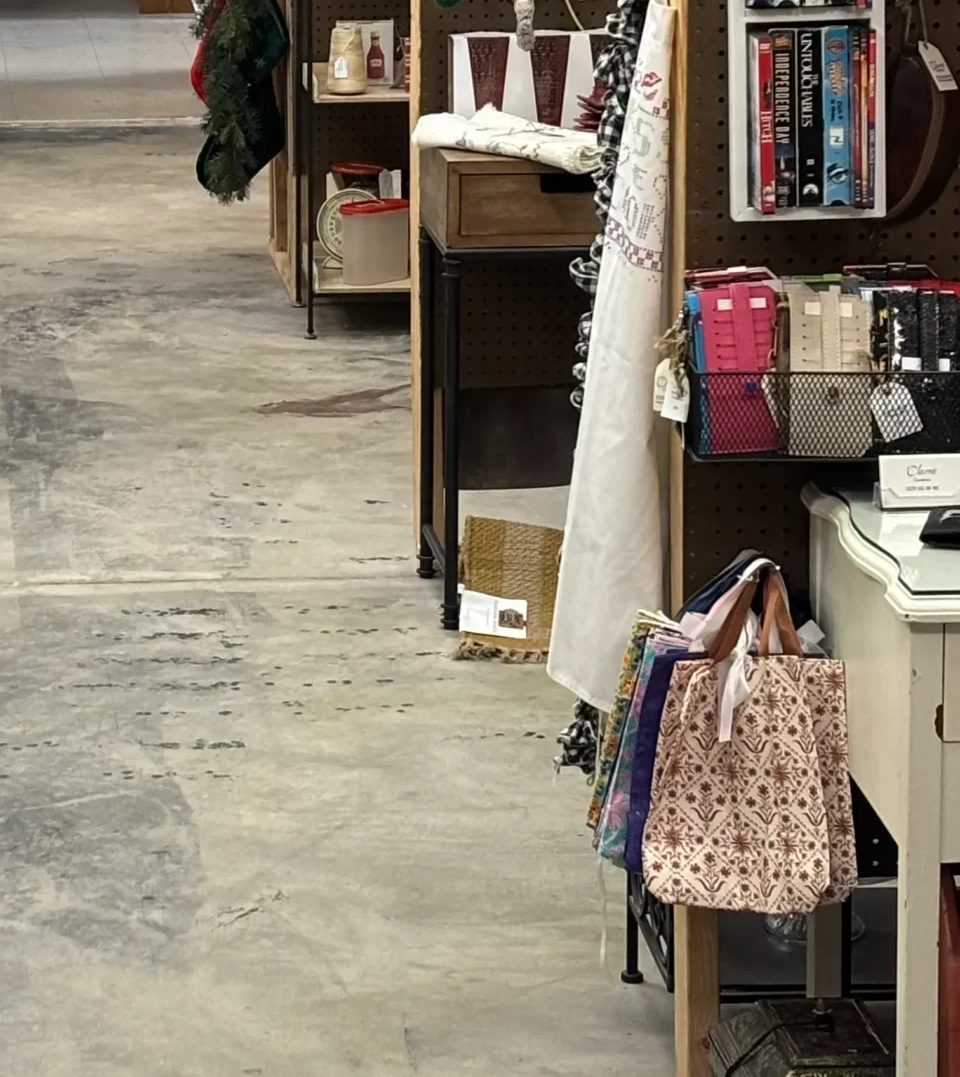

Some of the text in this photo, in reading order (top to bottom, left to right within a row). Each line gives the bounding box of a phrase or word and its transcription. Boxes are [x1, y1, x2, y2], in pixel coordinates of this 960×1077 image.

[800, 33, 813, 128] UNTOUCHABLES
[760, 110, 773, 143] HITCH
[775, 126, 790, 144] DAY
